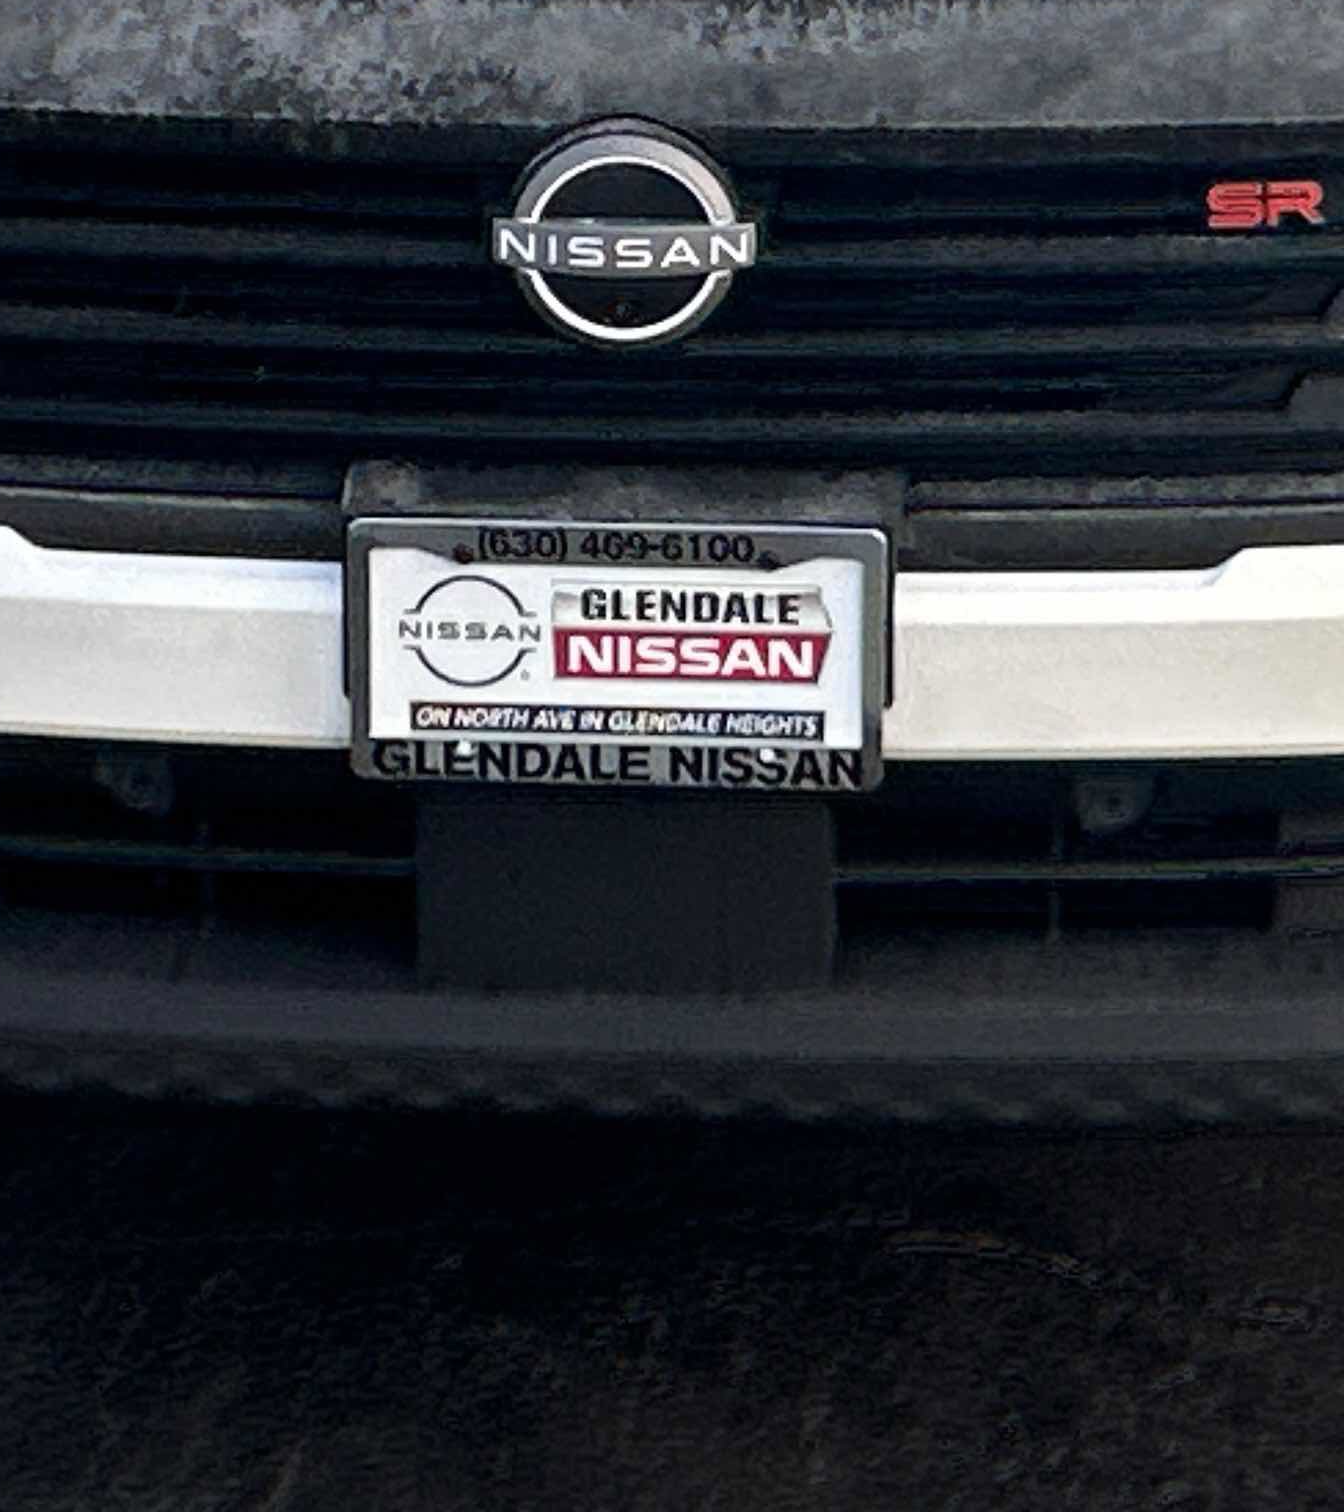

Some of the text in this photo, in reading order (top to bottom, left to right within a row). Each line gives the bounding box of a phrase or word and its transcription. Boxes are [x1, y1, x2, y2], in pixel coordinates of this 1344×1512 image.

[1207, 181, 1326, 229] SR
[499, 228, 749, 268] NISSAN
[478, 526, 754, 563] (630) 469-6100
[580, 589, 801, 626] GLENDALE
[398, 619, 541, 643] NISSAN
[568, 636, 814, 678] NISSAN
[416, 706, 818, 737] ON NORTH AVE IN GLENDALE HEIGHTS
[373, 741, 862, 786] GLENDALE NISSAN
